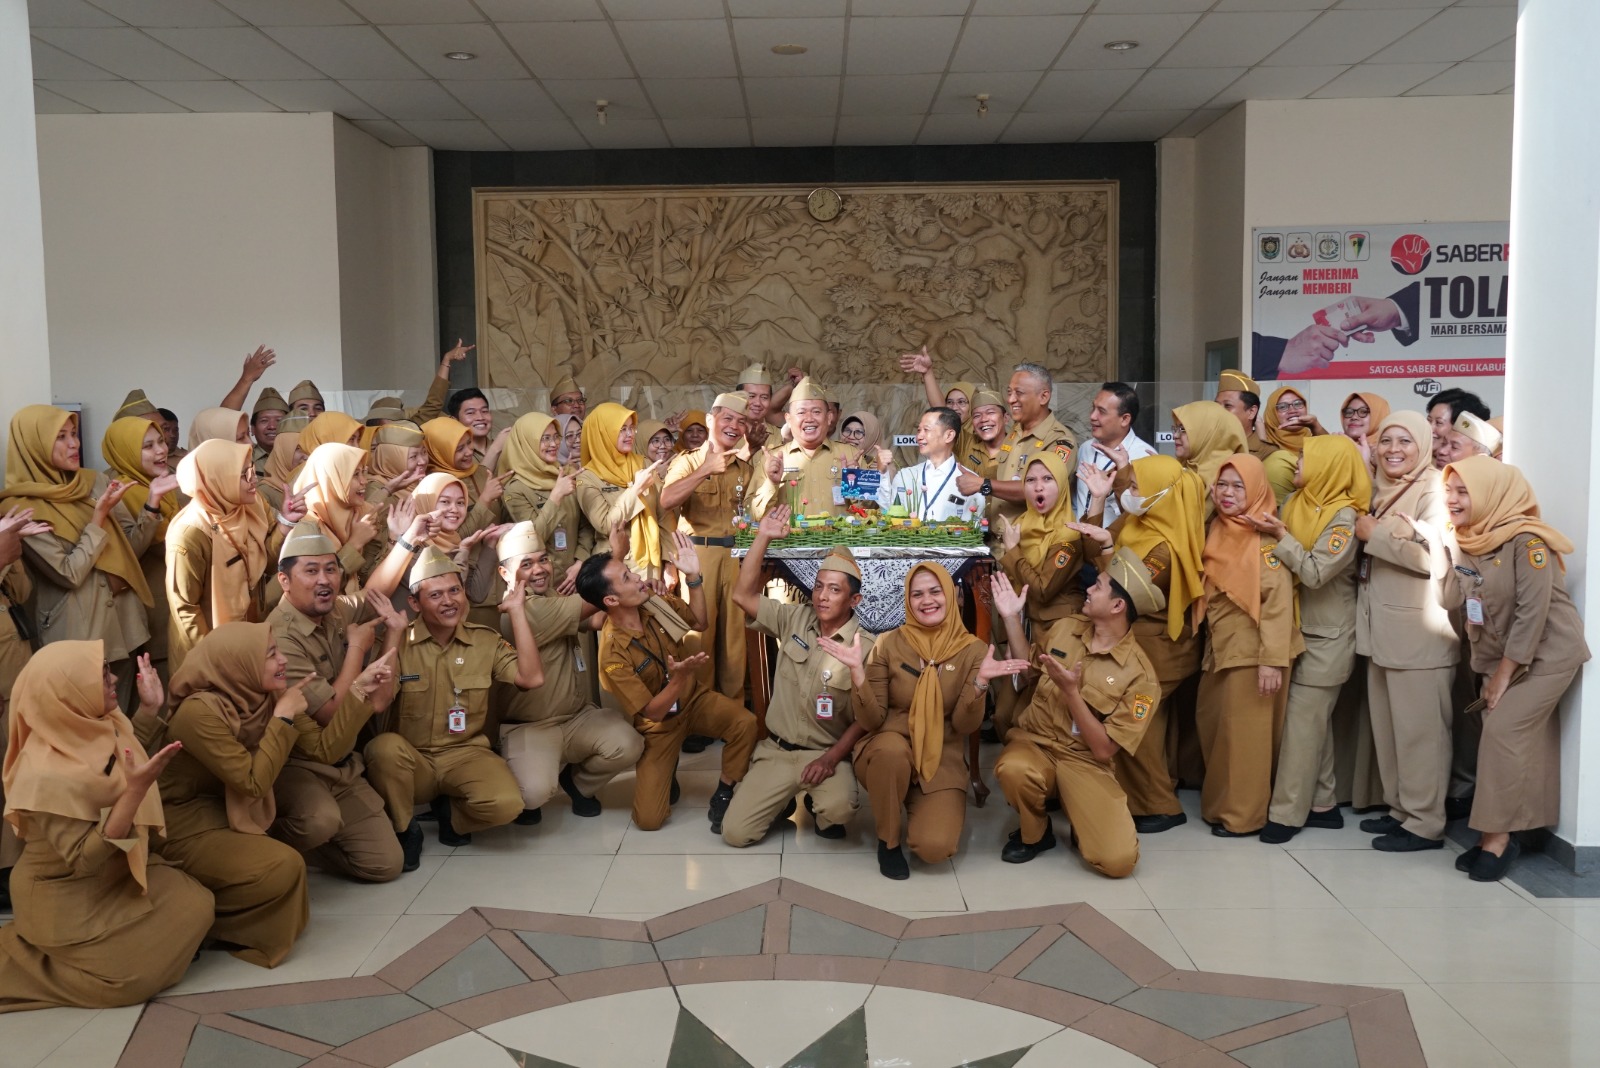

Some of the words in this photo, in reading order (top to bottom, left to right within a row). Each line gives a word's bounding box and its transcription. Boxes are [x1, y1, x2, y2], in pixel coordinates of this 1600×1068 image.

[1259, 271, 1298, 285] Jangan
[1303, 268, 1358, 280] MENERIMA
[1259, 285, 1298, 299] Jangan
[1303, 283, 1351, 294] MEMBERI
[1430, 325, 1457, 335] MARI
[1369, 365, 1404, 374] SATGAS
[1406, 364, 1436, 373] SABER
[1438, 363, 1473, 373] PUNGLI
